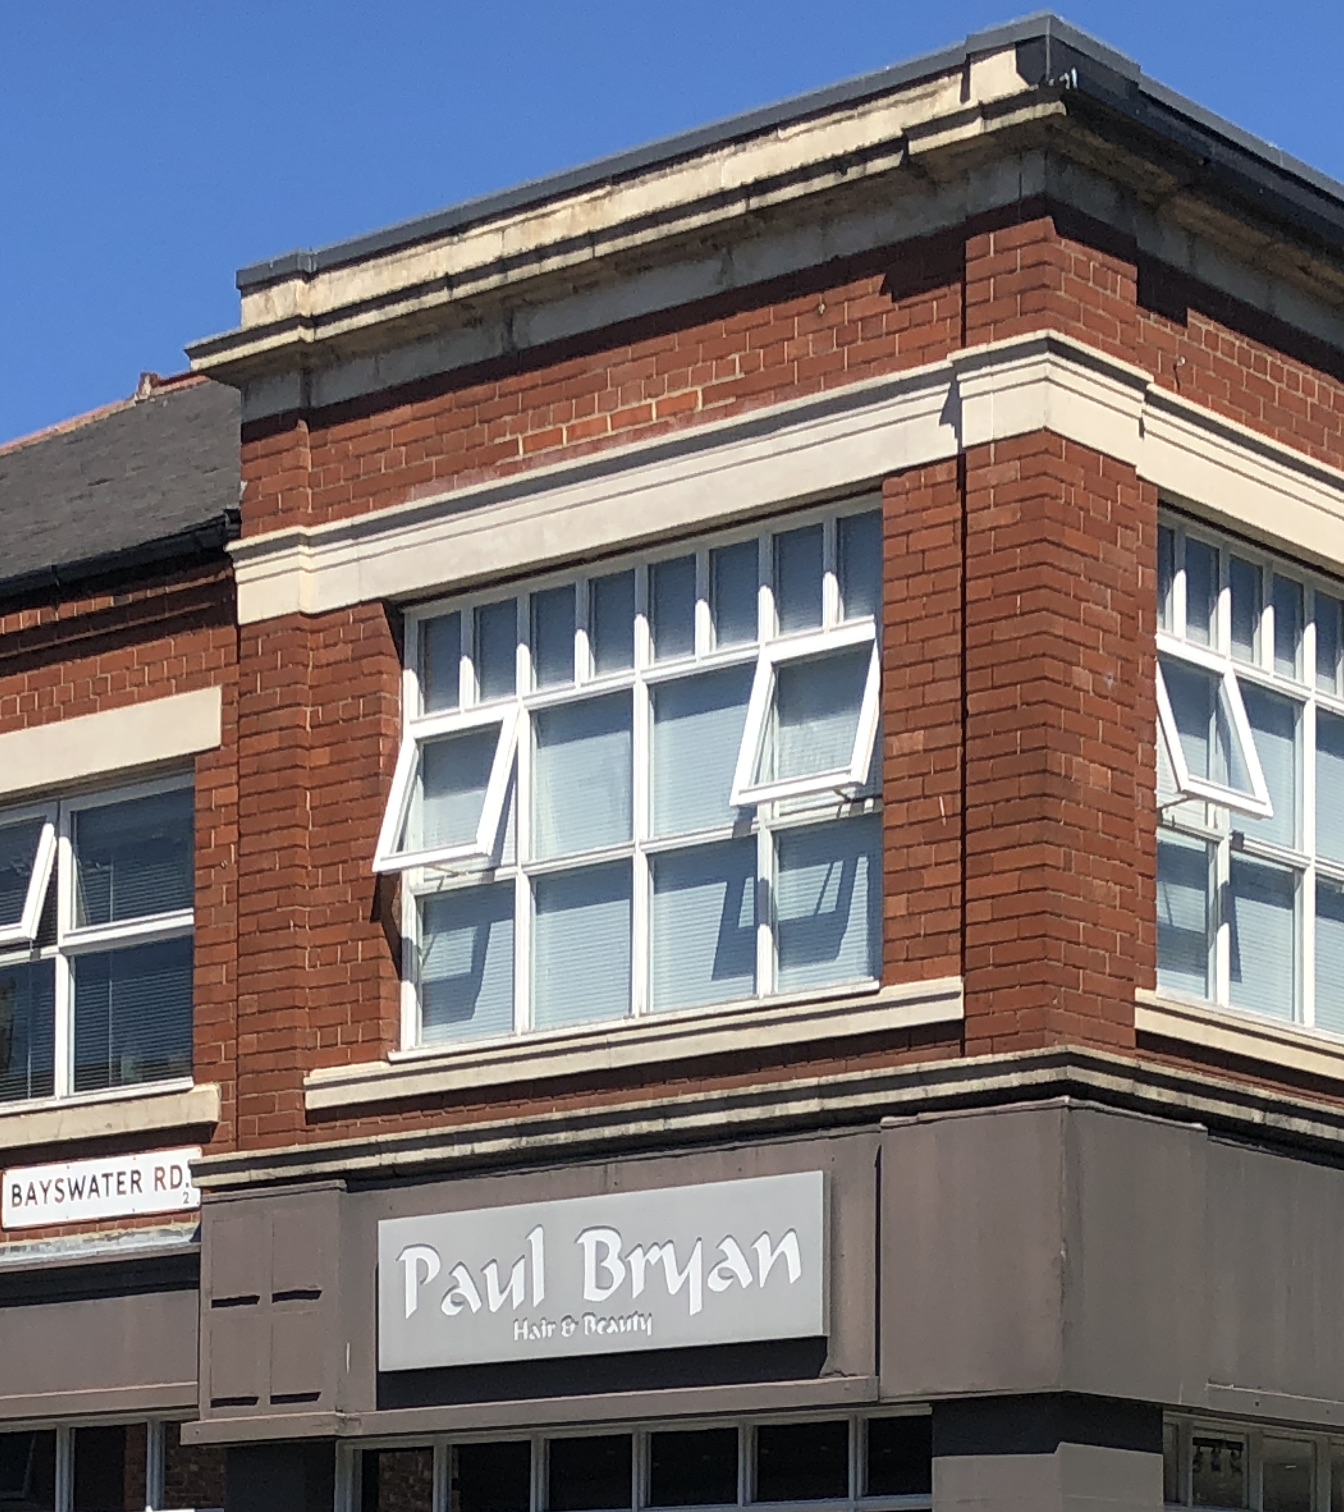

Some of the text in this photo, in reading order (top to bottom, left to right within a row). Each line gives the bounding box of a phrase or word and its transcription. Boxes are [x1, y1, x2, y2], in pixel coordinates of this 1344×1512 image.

[11, 1164, 190, 1208] BAYSWATER RD.
[182, 1191, 189, 1204] 2
[396, 1224, 802, 1319] Paul Bryan
[513, 1311, 654, 1341] Hair & Beauty
